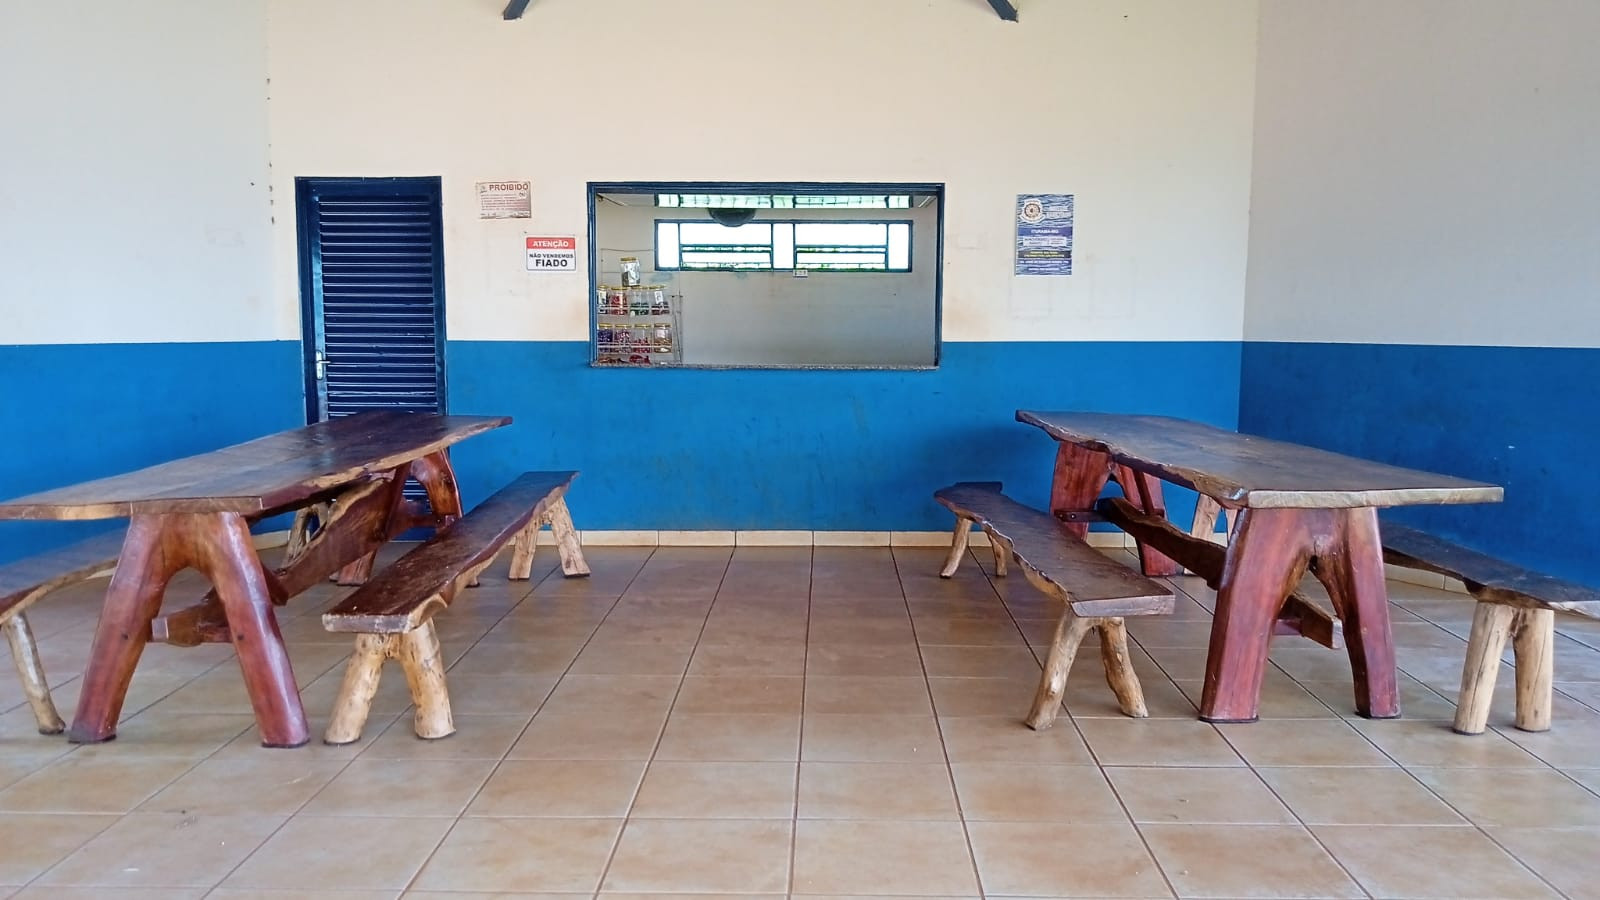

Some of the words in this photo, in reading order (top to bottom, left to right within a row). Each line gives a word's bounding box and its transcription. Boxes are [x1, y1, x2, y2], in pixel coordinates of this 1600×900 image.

[489, 183, 529, 191] PROIBIDO
[533, 240, 569, 248] ATENÇÃO
[535, 259, 568, 267] FIADO
